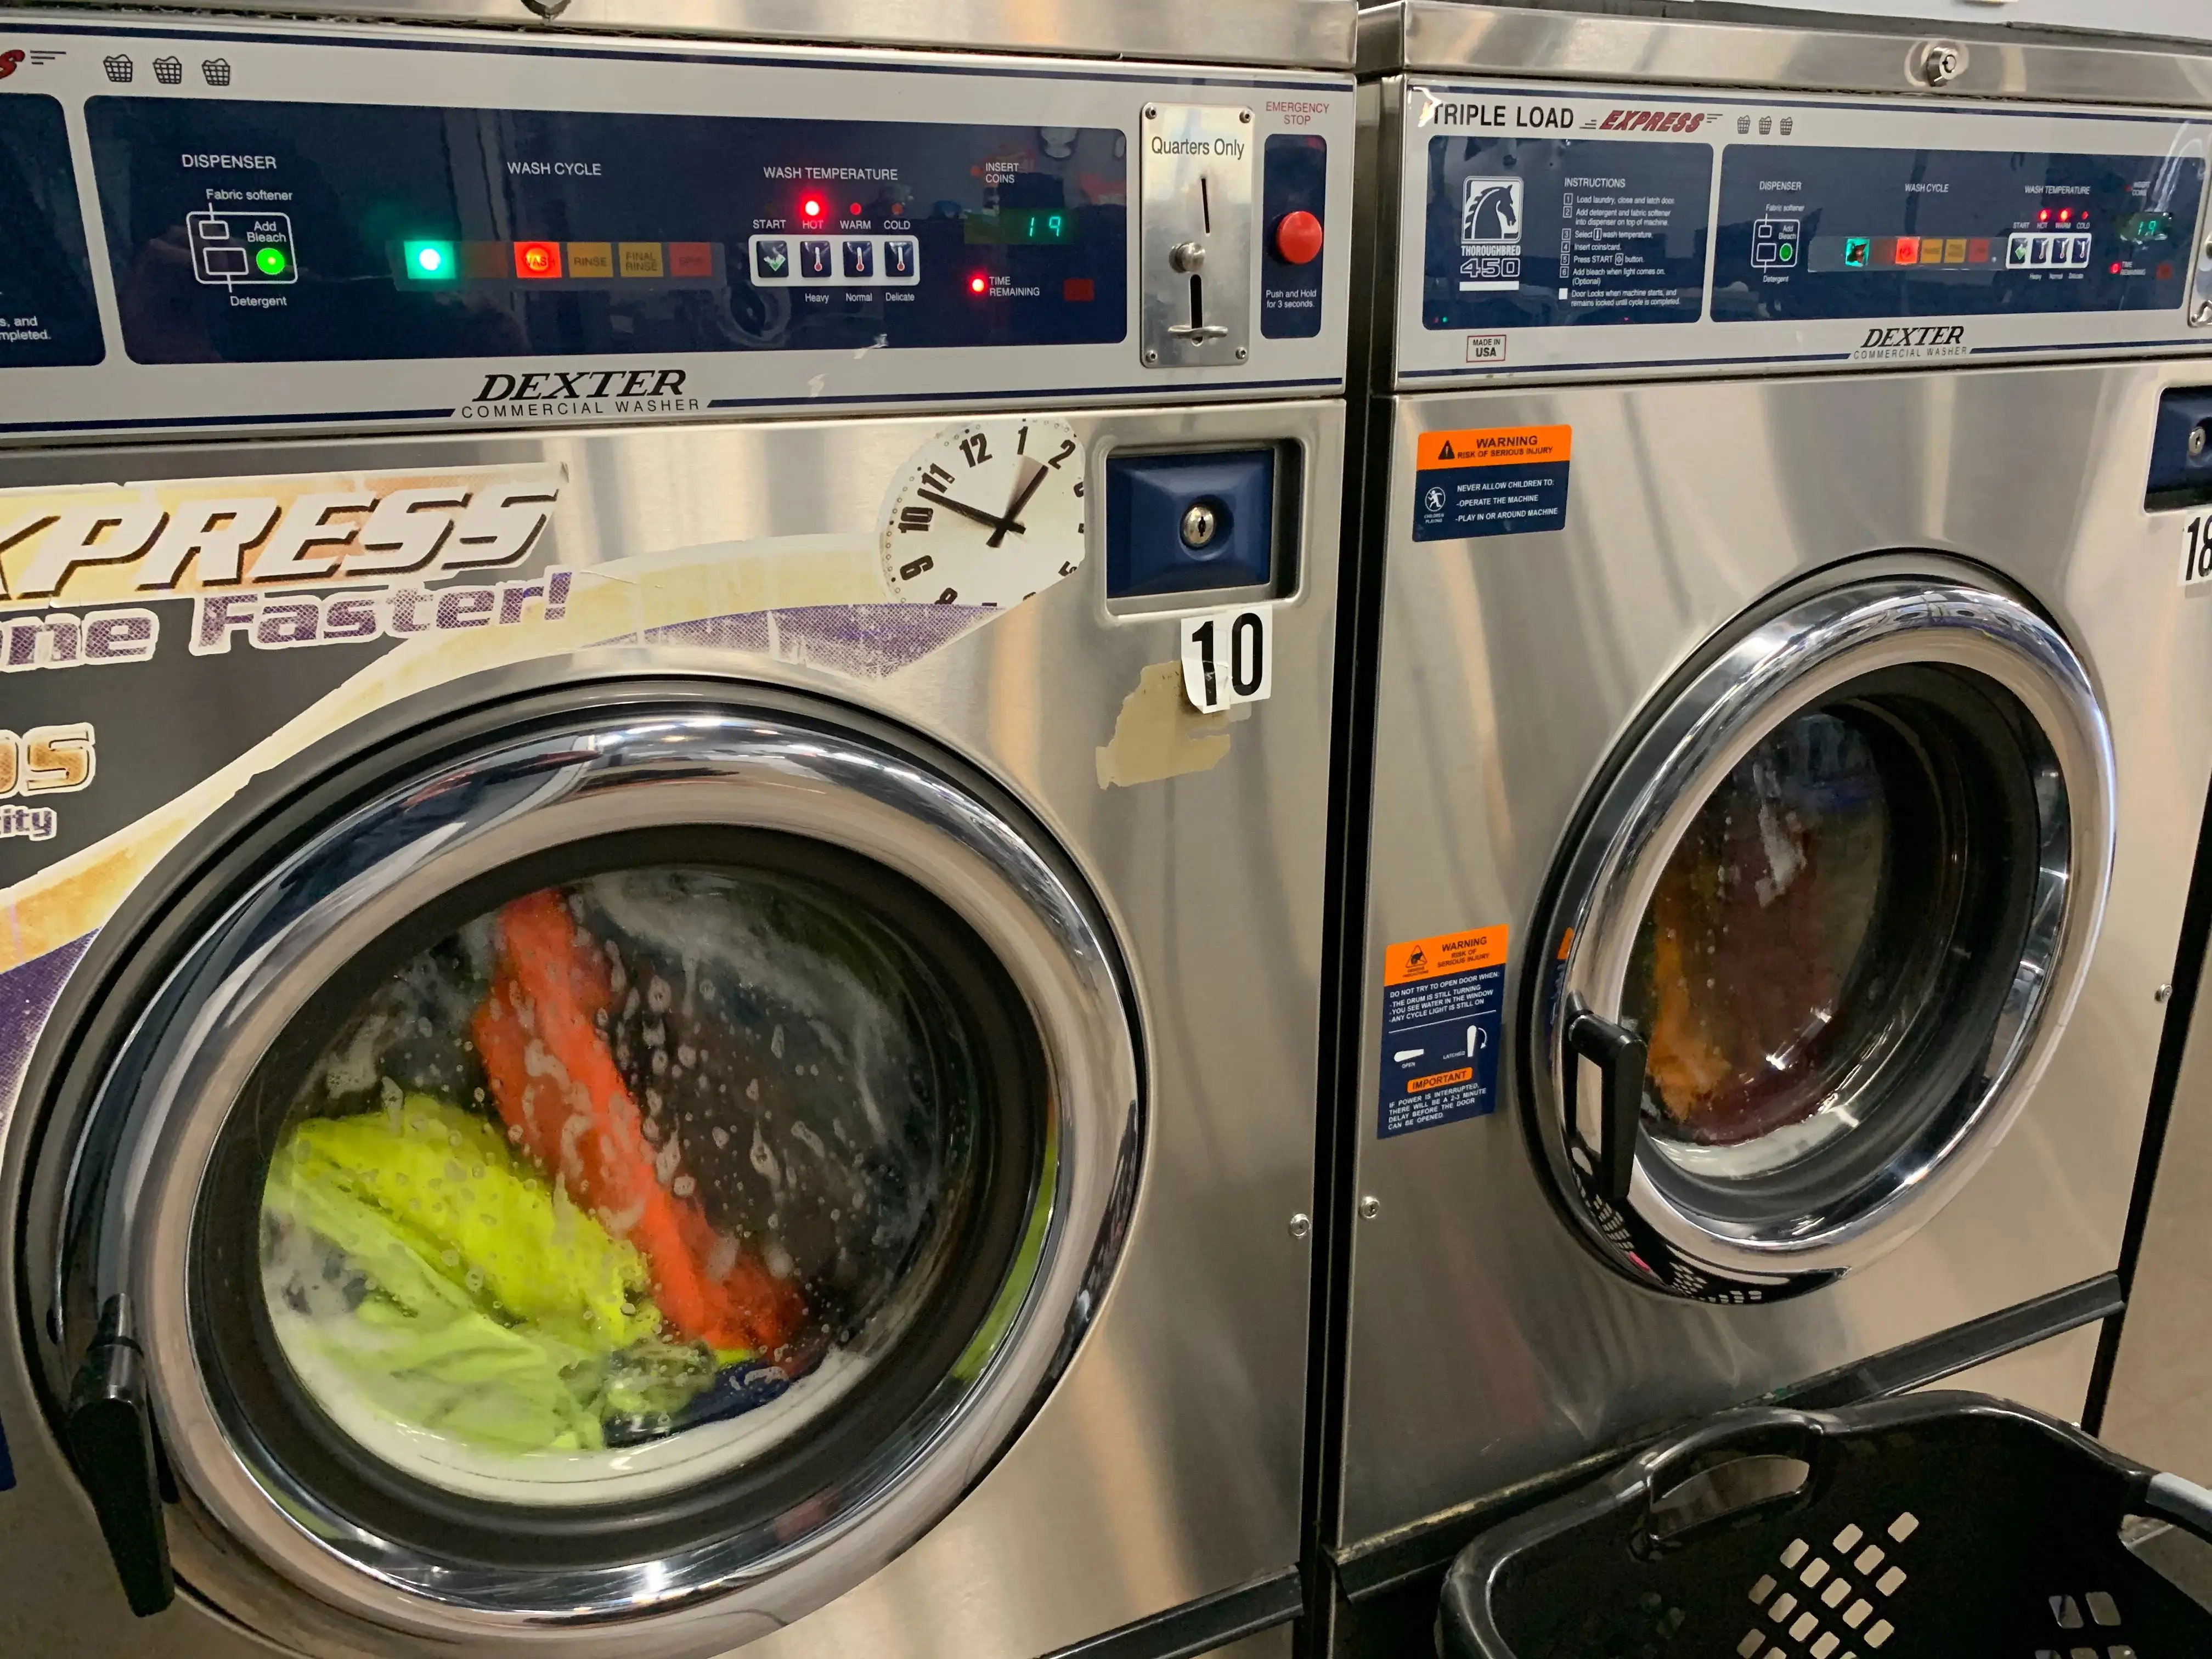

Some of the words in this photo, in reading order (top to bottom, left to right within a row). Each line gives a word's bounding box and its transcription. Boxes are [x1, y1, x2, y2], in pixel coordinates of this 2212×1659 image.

[1266, 101, 1329, 114] EMERGENCY
[1284, 115, 1311, 126] STOP
[1433, 104, 1505, 126] TRIPLE
[1516, 106, 1573, 128] LOAD
[1599, 110, 1704, 133] EXPRESS
[1152, 137, 1210, 155] Quarters
[1215, 138, 1245, 160] Only
[182, 155, 276, 169] DISPENSER
[985, 162, 1019, 172] INSERT
[507, 162, 550, 175] WASH
[554, 163, 601, 176] CYCLE
[764, 167, 802, 179] WASH
[805, 167, 898, 180] TEMPERATURE
[986, 174, 1015, 184] COINS
[1565, 178, 1625, 188] INSTRUCTIONS
[1759, 181, 1802, 191] DISPENSER
[1905, 183, 1925, 193] WASH
[1927, 184, 1949, 193] CYCLE
[2025, 185, 2043, 194] WASH
[2045, 186, 2090, 195] TEMPERATURE
[206, 189, 242, 200] Fabric
[246, 189, 293, 201] softener
[1593, 196, 1616, 205] laundry,
[1589, 209, 1617, 217] detergent
[253, 221, 276, 231] Add
[753, 219, 786, 229] START
[803, 221, 823, 229] HOT
[840, 221, 871, 230] WARM
[884, 221, 911, 230] COLD
[1029, 216, 1062, 237] 19
[247, 232, 286, 242] Bleach
[625, 252, 656, 261] FINAL
[1461, 245, 1521, 257] THOROUGHBRED
[522, 257, 556, 267] WASH
[574, 257, 607, 267] RINSE
[625, 261, 658, 271] RINSE
[1460, 258, 1520, 278] 450
[989, 276, 1011, 285] TIME
[1572, 278, 1600, 286] (Optional)
[1763, 275, 1788, 284] Detergent
[845, 292, 873, 302] Normal
[885, 292, 915, 302] Delicate
[990, 287, 1040, 296] REMAINING
[1300, 289, 1317, 298] Hold
[230, 296, 287, 308] Detergent
[805, 293, 829, 304] Heavy
[1284, 300, 1314, 308] seconds.
[14, 316, 37, 326] and
[1861, 326, 1964, 348] DEXTER
[1476, 347, 1497, 357] USA
[1854, 348, 1921, 359] COMMERCIAL
[1927, 347, 1967, 357] WASHER
[473, 369, 686, 402] DEXTER
[462, 402, 603, 419] COMMERCIAL
[616, 398, 699, 412] WASHER
[1018, 426, 1028, 455] 1
[1476, 436, 1538, 448] WARNING
[960, 433, 992, 467] 12
[1048, 439, 1076, 470] 2
[1491, 449, 1523, 457] SERIOUS
[1526, 447, 1553, 455] INJURY
[921, 463, 955, 493] 11
[1457, 484, 1481, 492] NEVER
[1482, 482, 1507, 490] ALLOW
[1508, 480, 1542, 489] CHILDREN
[1457, 498, 1491, 507] -OPERATE
[1508, 495, 1538, 503] MACHINE
[898, 507, 933, 533] 10
[1455, 514, 1475, 522] -PLAY
[1498, 510, 1526, 518] AROUND
[1528, 507, 1558, 516] MACHINE
[2186, 515, 2212, 581] 18
[900, 555, 933, 580] 9
[0, 617, 153, 665] ne
[198, 572, 572, 646] Faster!
[1192, 612, 1262, 707] 10
[1442, 936, 1487, 952] WARNING
[1437, 958, 1465, 968] SERIOUS
[1467, 953, 1489, 963] INJURY
[1440, 980, 1457, 988] OPEN
[1459, 975, 1477, 984] DOOR
[1407, 995, 1425, 1005] DRUM
[1434, 991, 1451, 1000] STILL
[1453, 985, 1481, 996] TURNING
[1421, 999, 1443, 1009] WATER
[1466, 989, 1493, 1000] WINDOW
[1406, 1009, 1427, 1019] CYCLE
[1429, 1005, 1447, 1014] LIGHT
[1457, 1000, 1474, 1009] STILL
[1443, 1051, 1465, 1059] LATCHED
[1413, 1070, 1467, 1090] IMPORTANT
[1390, 1106, 1410, 1115] THERE
[1413, 1102, 1429, 1111] WILL
[1463, 1088, 1486, 1098] MINUTE
[1398, 1096, 1422, 1107] POWER
[1389, 1114, 1409, 1123] DELAY
[1412, 1107, 1438, 1117] BEFORE
[1457, 1098, 1475, 1107] DOOR
[1417, 1113, 1444, 1123] OPENED.
